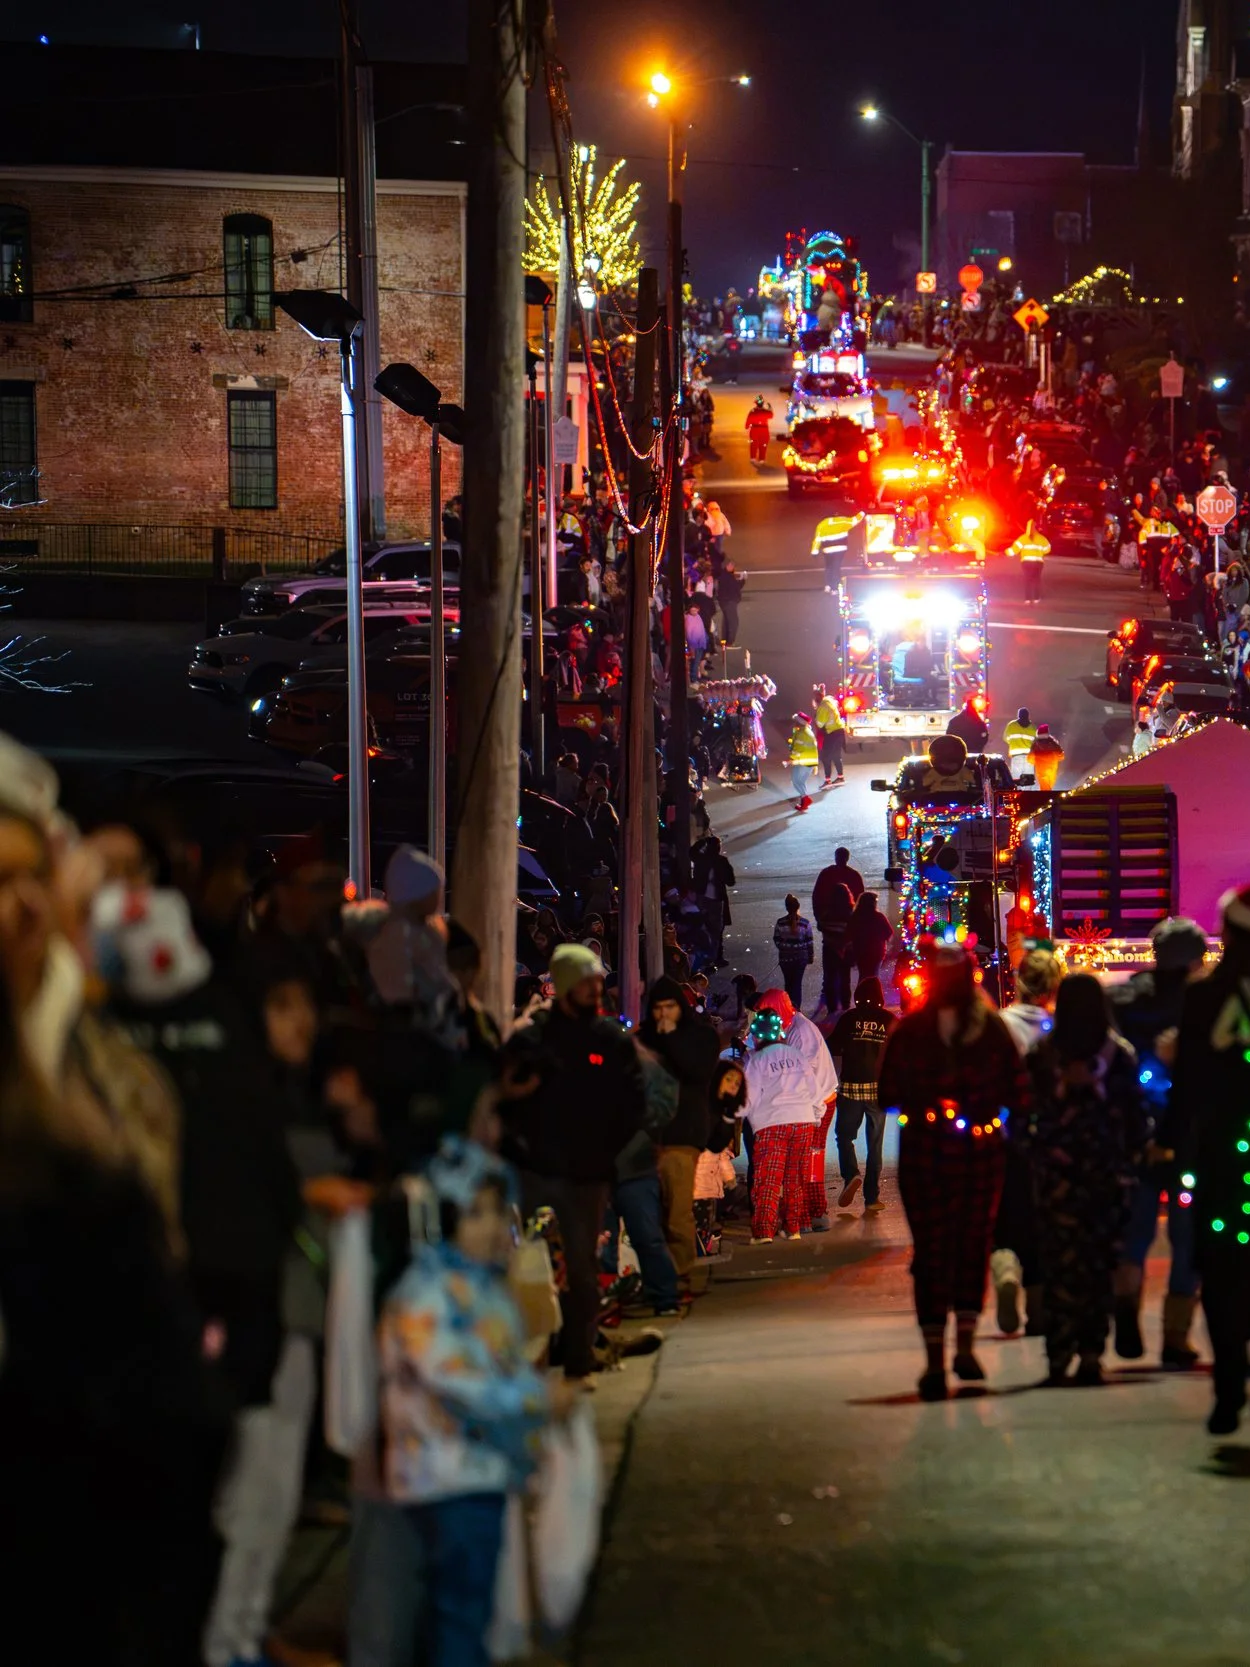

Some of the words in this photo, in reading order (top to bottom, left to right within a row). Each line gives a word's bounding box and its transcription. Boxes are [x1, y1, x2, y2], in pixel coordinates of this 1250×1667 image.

[1200, 499, 1234, 514] STOP
[397, 692, 417, 701] LOT
[855, 1021, 886, 1032] REDA
[769, 1058, 802, 1073] REDA
